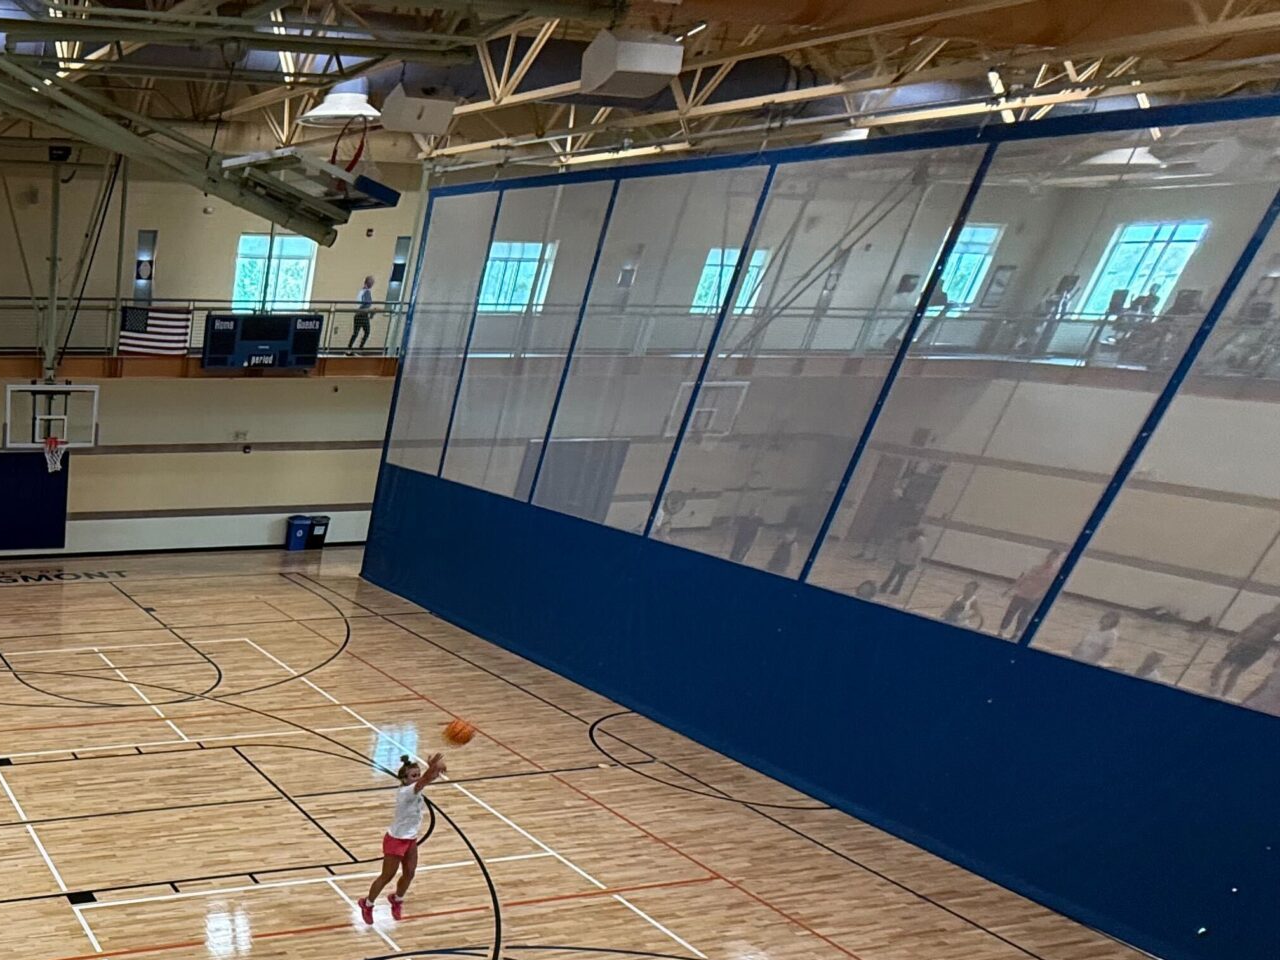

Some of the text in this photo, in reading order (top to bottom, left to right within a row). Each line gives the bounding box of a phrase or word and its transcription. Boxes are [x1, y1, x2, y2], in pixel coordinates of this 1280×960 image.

[215, 319, 234, 330] Home
[297, 319, 320, 330] Guests
[251, 354, 274, 366] period
